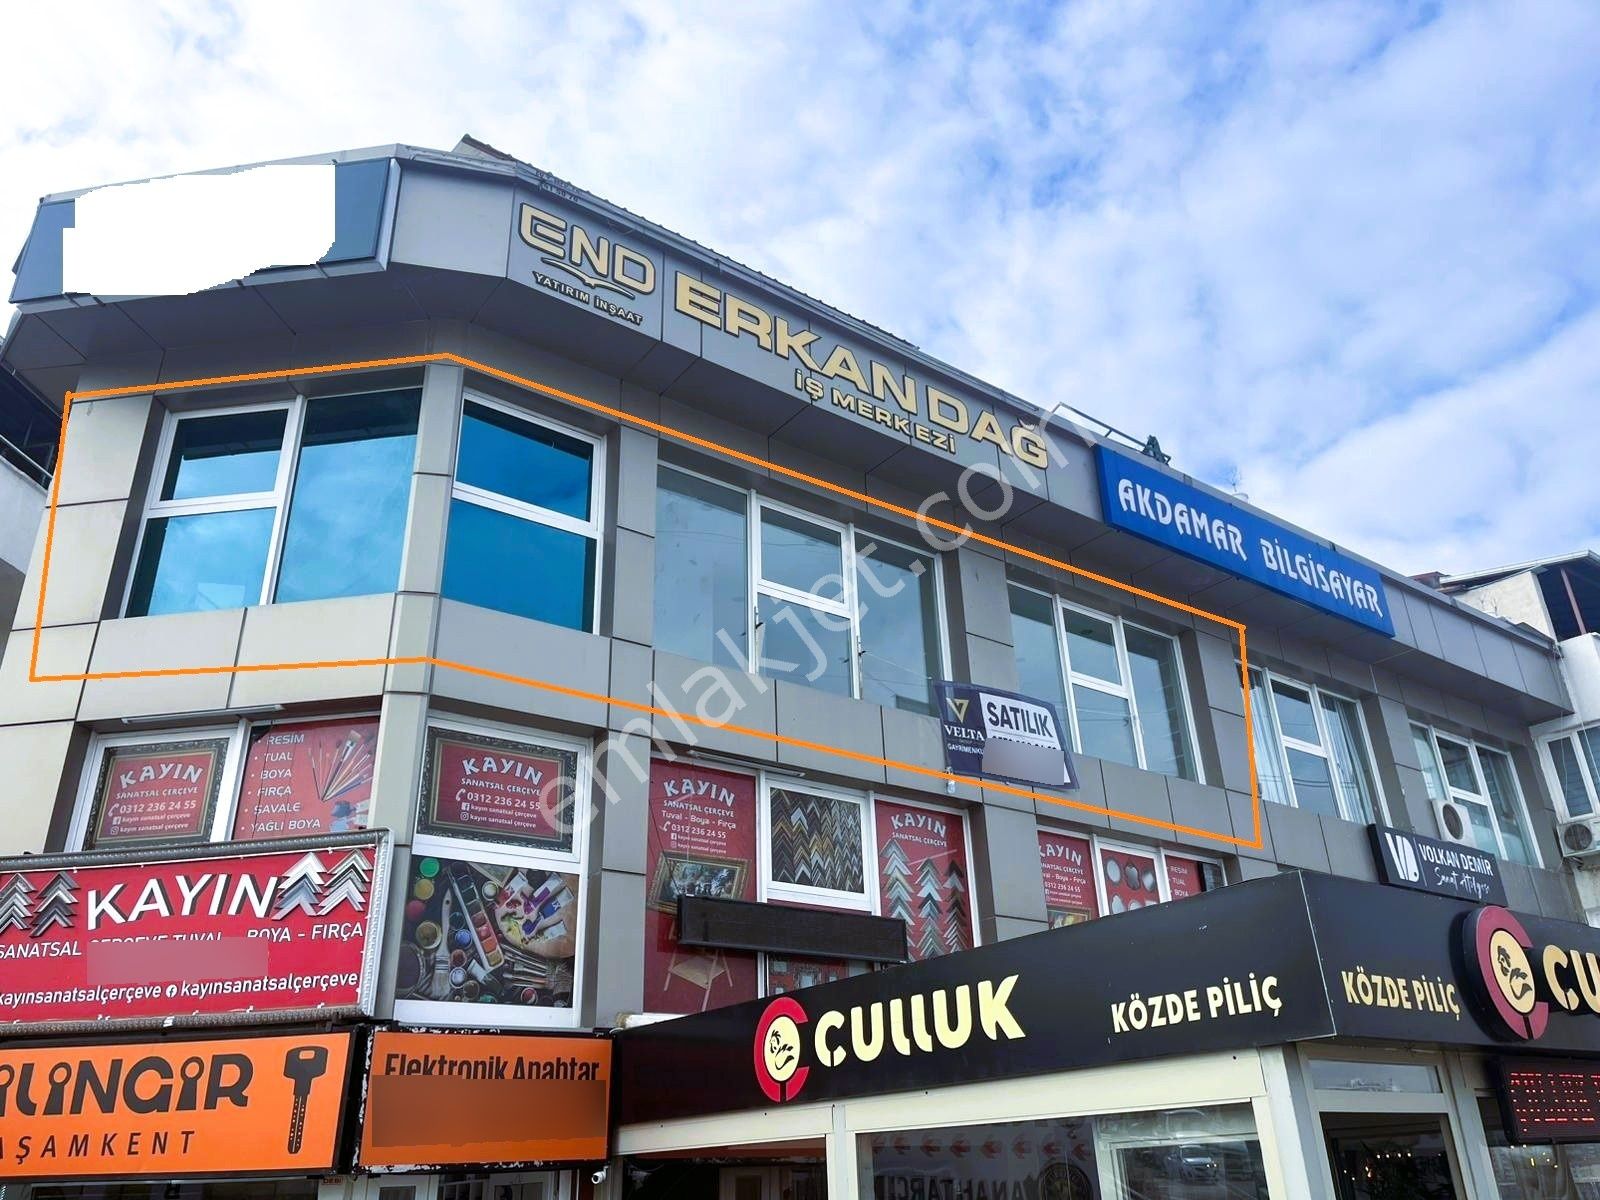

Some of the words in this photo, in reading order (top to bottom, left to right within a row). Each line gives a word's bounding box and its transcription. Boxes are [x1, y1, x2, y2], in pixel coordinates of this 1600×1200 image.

[519, 202, 656, 295] END
[532, 271, 590, 305] YATIRIM
[594, 295, 643, 326] İNŞAAT
[795, 369, 824, 400] İŞ
[832, 387, 956, 455] MERKEZİ
[1118, 478, 1247, 561] AKDAMAR
[1260, 538, 1383, 618] BİLGİSAYAR
[943, 724, 985, 741] VELTA
[986, 701, 1054, 738] SATILIK
[264, 752, 293, 762] TUAL
[462, 756, 544, 786] KAYIN
[119, 763, 203, 790] KAYIN
[261, 769, 292, 779] BOYA
[461, 778, 505, 791] SANATSAL
[115, 790, 160, 800] SANATSAL
[257, 786, 292, 797] FIRÇA
[467, 792, 492, 804] 0312
[494, 796, 513, 807] 236
[514, 800, 527, 809] 24
[529, 802, 541, 811] 55
[663, 778, 736, 808] KAYIN
[119, 803, 144, 814] 0312
[146, 801, 166, 812] 236
[168, 801, 181, 810] 24
[184, 800, 197, 809] 55
[254, 803, 301, 815] SAVALE
[663, 800, 702, 813] SANATSAL
[690, 814, 710, 826] Boya
[288, 818, 321, 830] BOYA
[671, 823, 690, 834] 0312
[691, 826, 706, 836] 236
[706, 829, 716, 838] 24
[717, 830, 727, 840] 55
[890, 812, 947, 839] KAYIN
[1418, 843, 1461, 869] VOLKAN
[1460, 853, 1494, 876] DEMİR
[87, 872, 280, 932] KAYIN
[0, 941, 82, 960] SANATSAL
[311, 922, 363, 942] FIRÇA
[0, 984, 161, 1009] kayınsanatsalçerçeve
[181, 972, 358, 1000] kayınsanatsalçerçeve
[1111, 992, 1201, 1034] KÖZDE
[1206, 972, 1283, 1019] PİLİÇ
[1341, 965, 1412, 1010] KÖZDE
[1411, 974, 1460, 1021] PİLİÇ
[384, 1052, 508, 1080] Elektronik
[512, 1055, 600, 1081] Anahtar
[0, 1130, 195, 1165] ŞAMKENT
